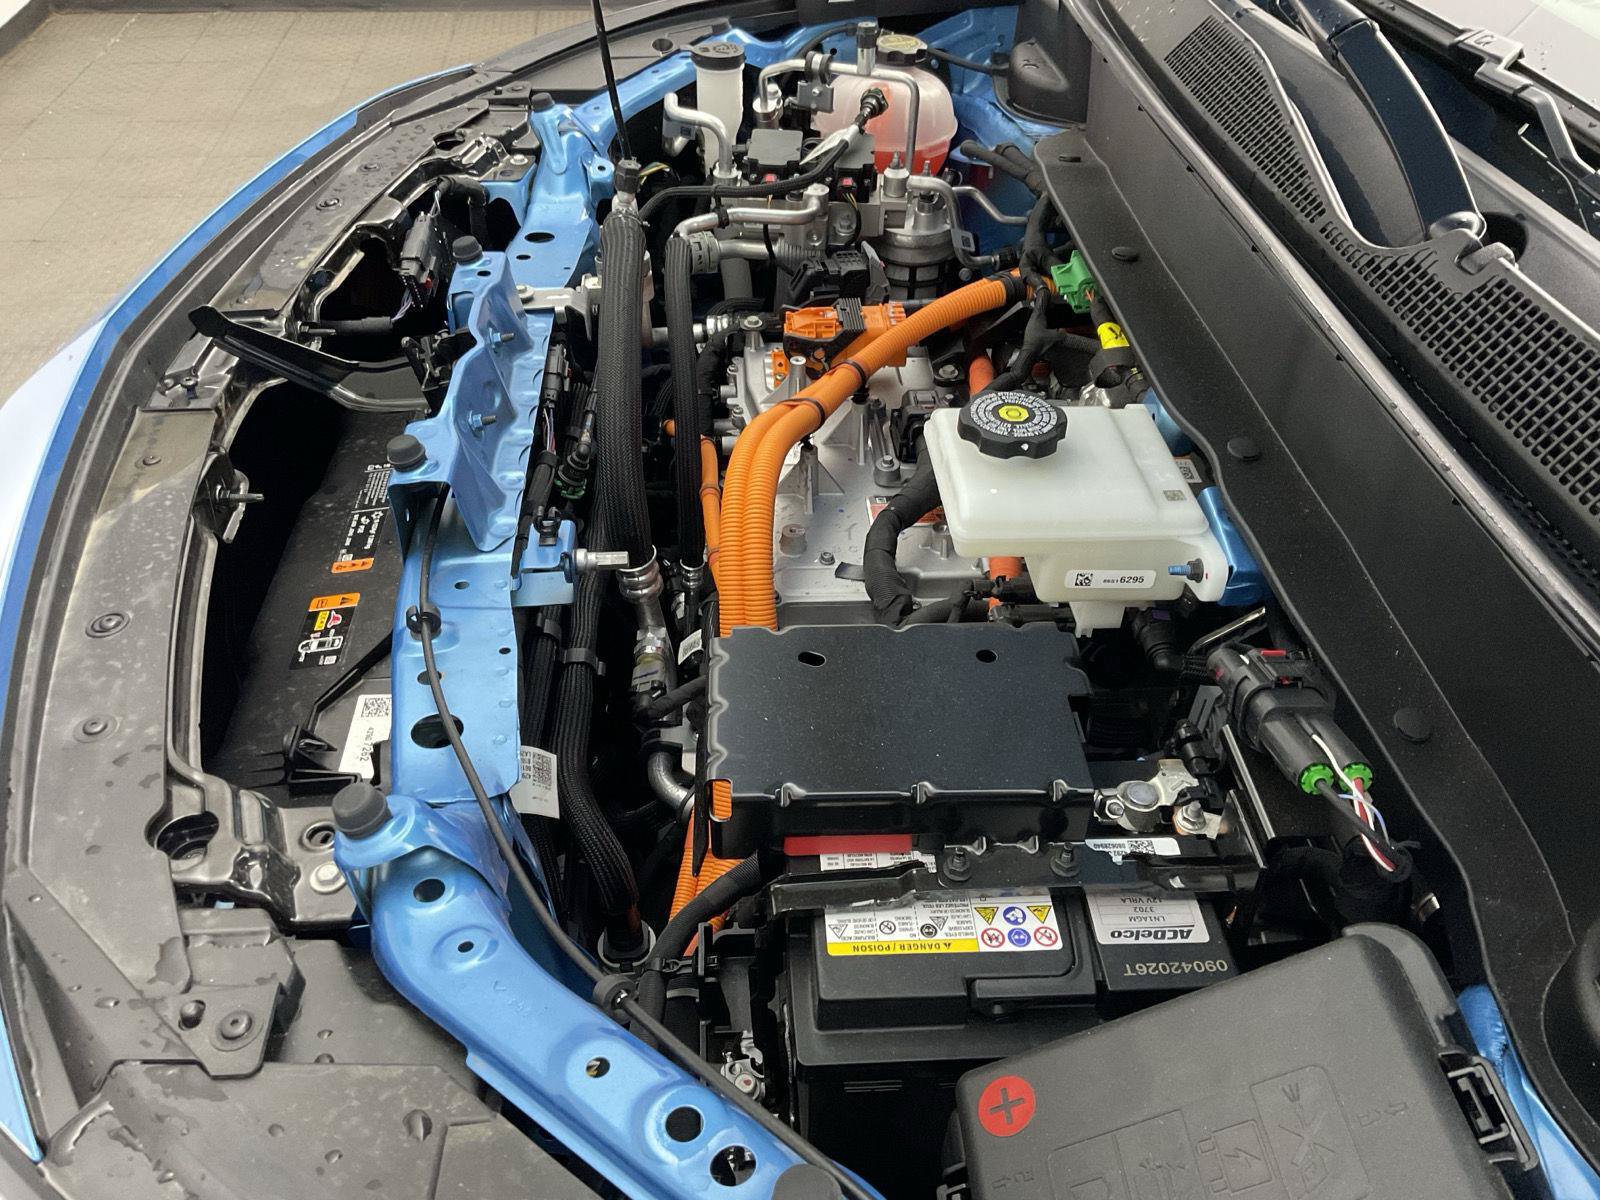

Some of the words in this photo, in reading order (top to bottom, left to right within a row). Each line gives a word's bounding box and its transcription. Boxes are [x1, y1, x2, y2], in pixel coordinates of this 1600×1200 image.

[1110, 929, 1193, 941] ACDelco
[852, 944, 891, 952] POISON
[899, 942, 940, 950] DANGER
[1123, 960, 1228, 976] 09042026T
